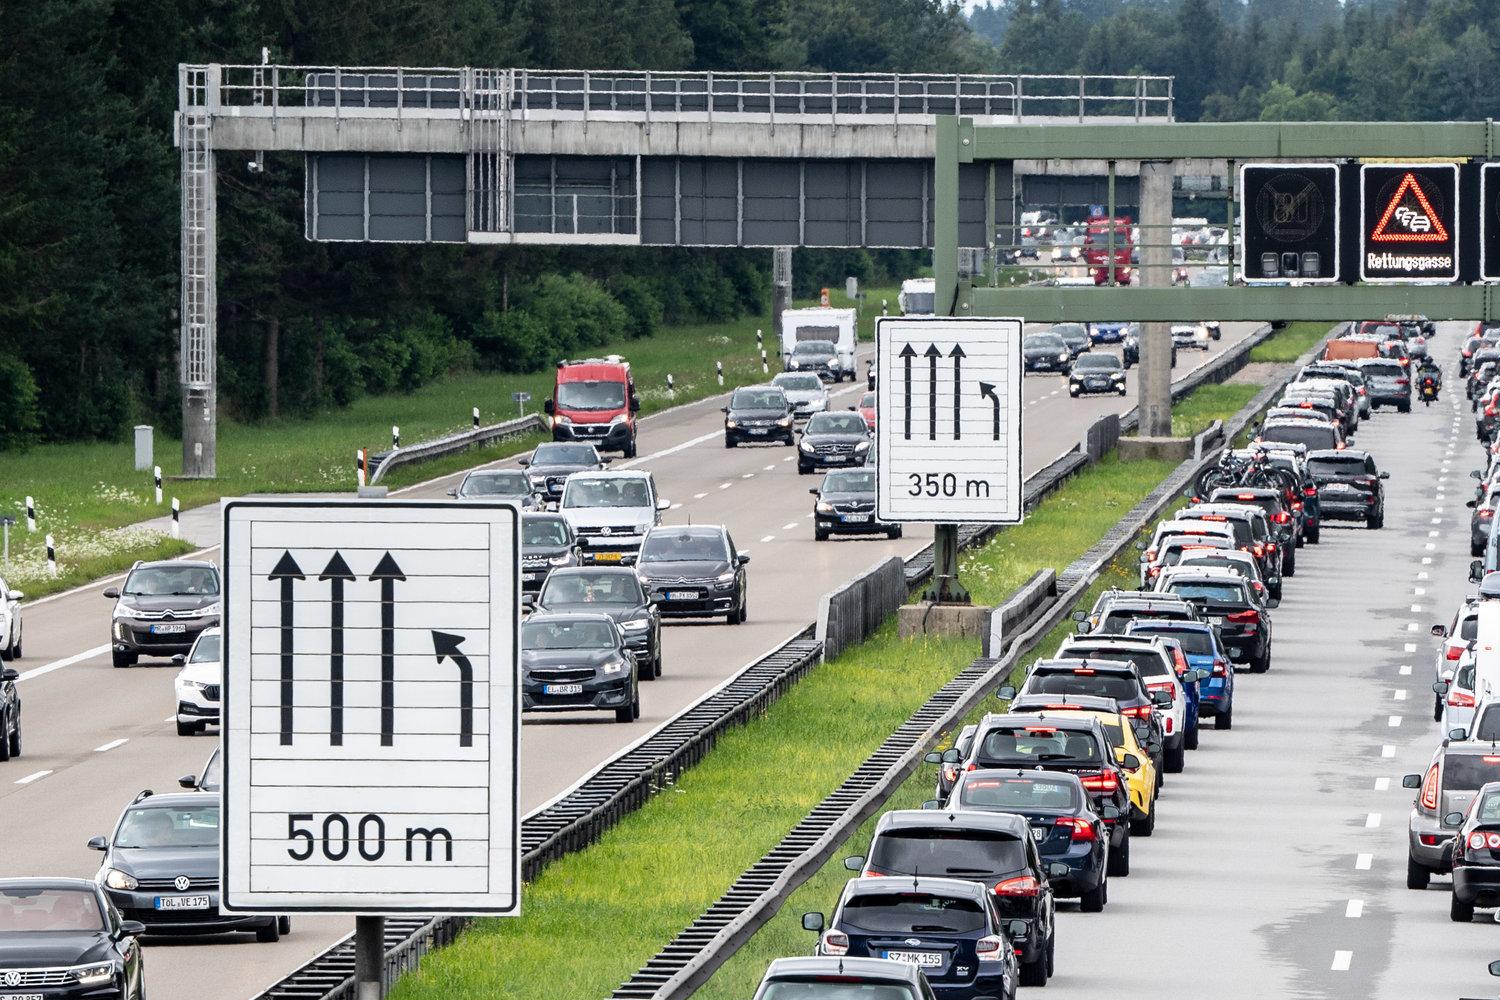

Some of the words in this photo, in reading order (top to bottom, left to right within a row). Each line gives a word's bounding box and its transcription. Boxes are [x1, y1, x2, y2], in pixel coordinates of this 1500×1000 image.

[1367, 252, 1453, 271] Rettungsgasse
[908, 473, 957, 498] 350
[966, 480, 990, 498] m
[287, 814, 386, 861] 500
[405, 827, 454, 862] m
[182, 898, 192, 907] VE
[194, 896, 208, 906] 175
[907, 953, 920, 963] MK
[922, 954, 941, 964] 155
